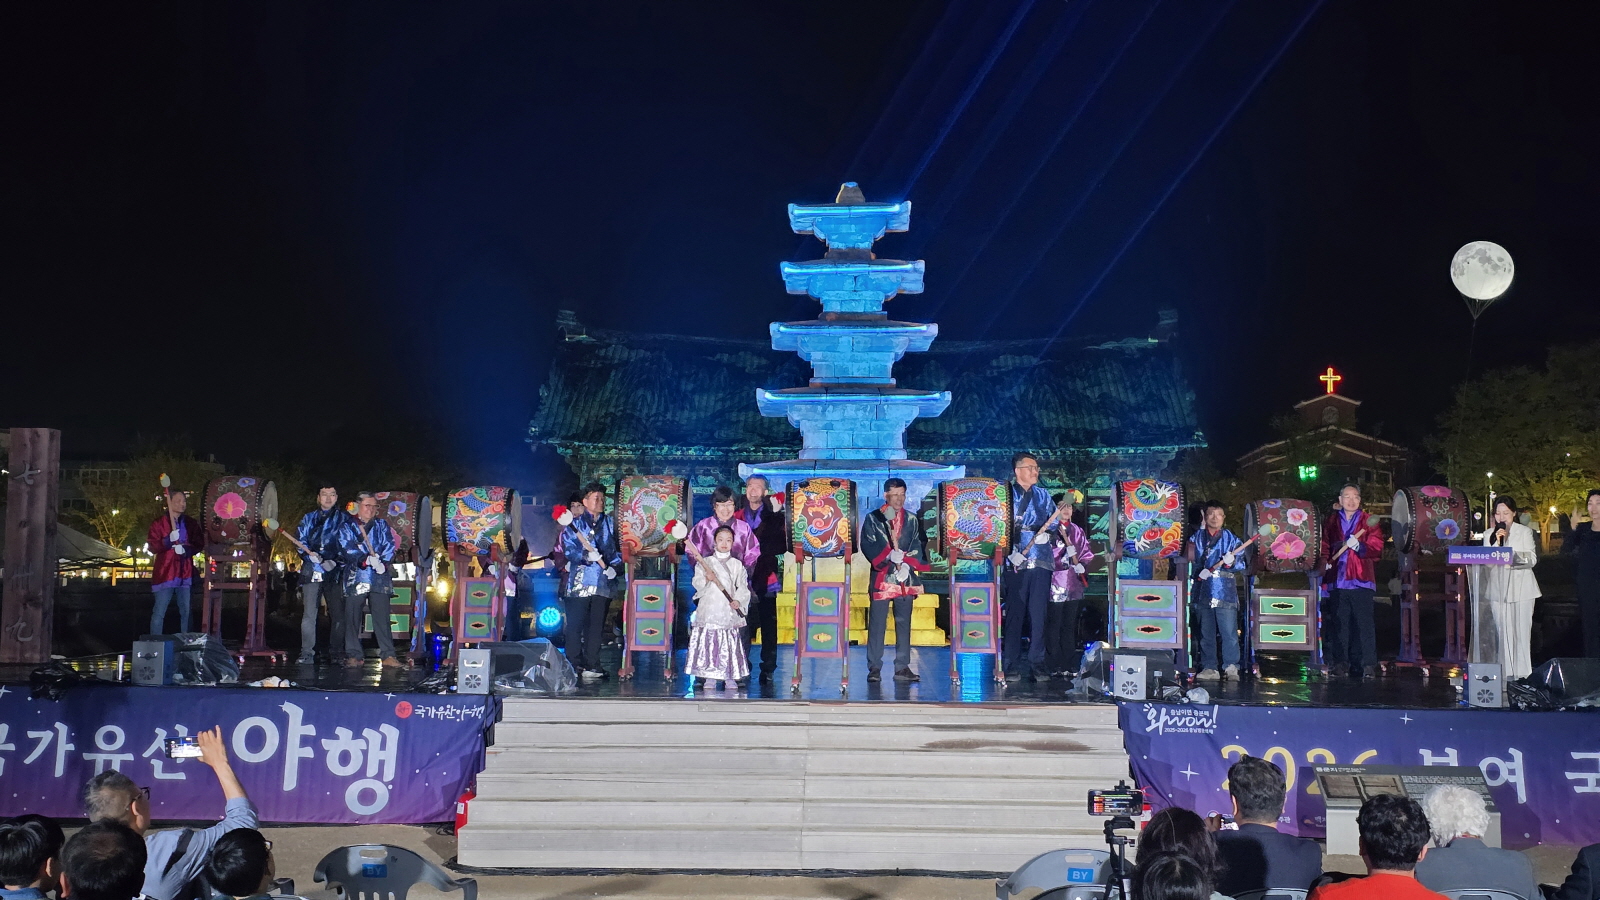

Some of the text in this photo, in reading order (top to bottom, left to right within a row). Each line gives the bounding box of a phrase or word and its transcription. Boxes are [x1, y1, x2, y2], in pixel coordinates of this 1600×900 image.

[1491, 550, 1510, 562] 야행
[232, 700, 400, 815] 야행
[366, 868, 382, 876] BY
[1072, 870, 1089, 880] BY
